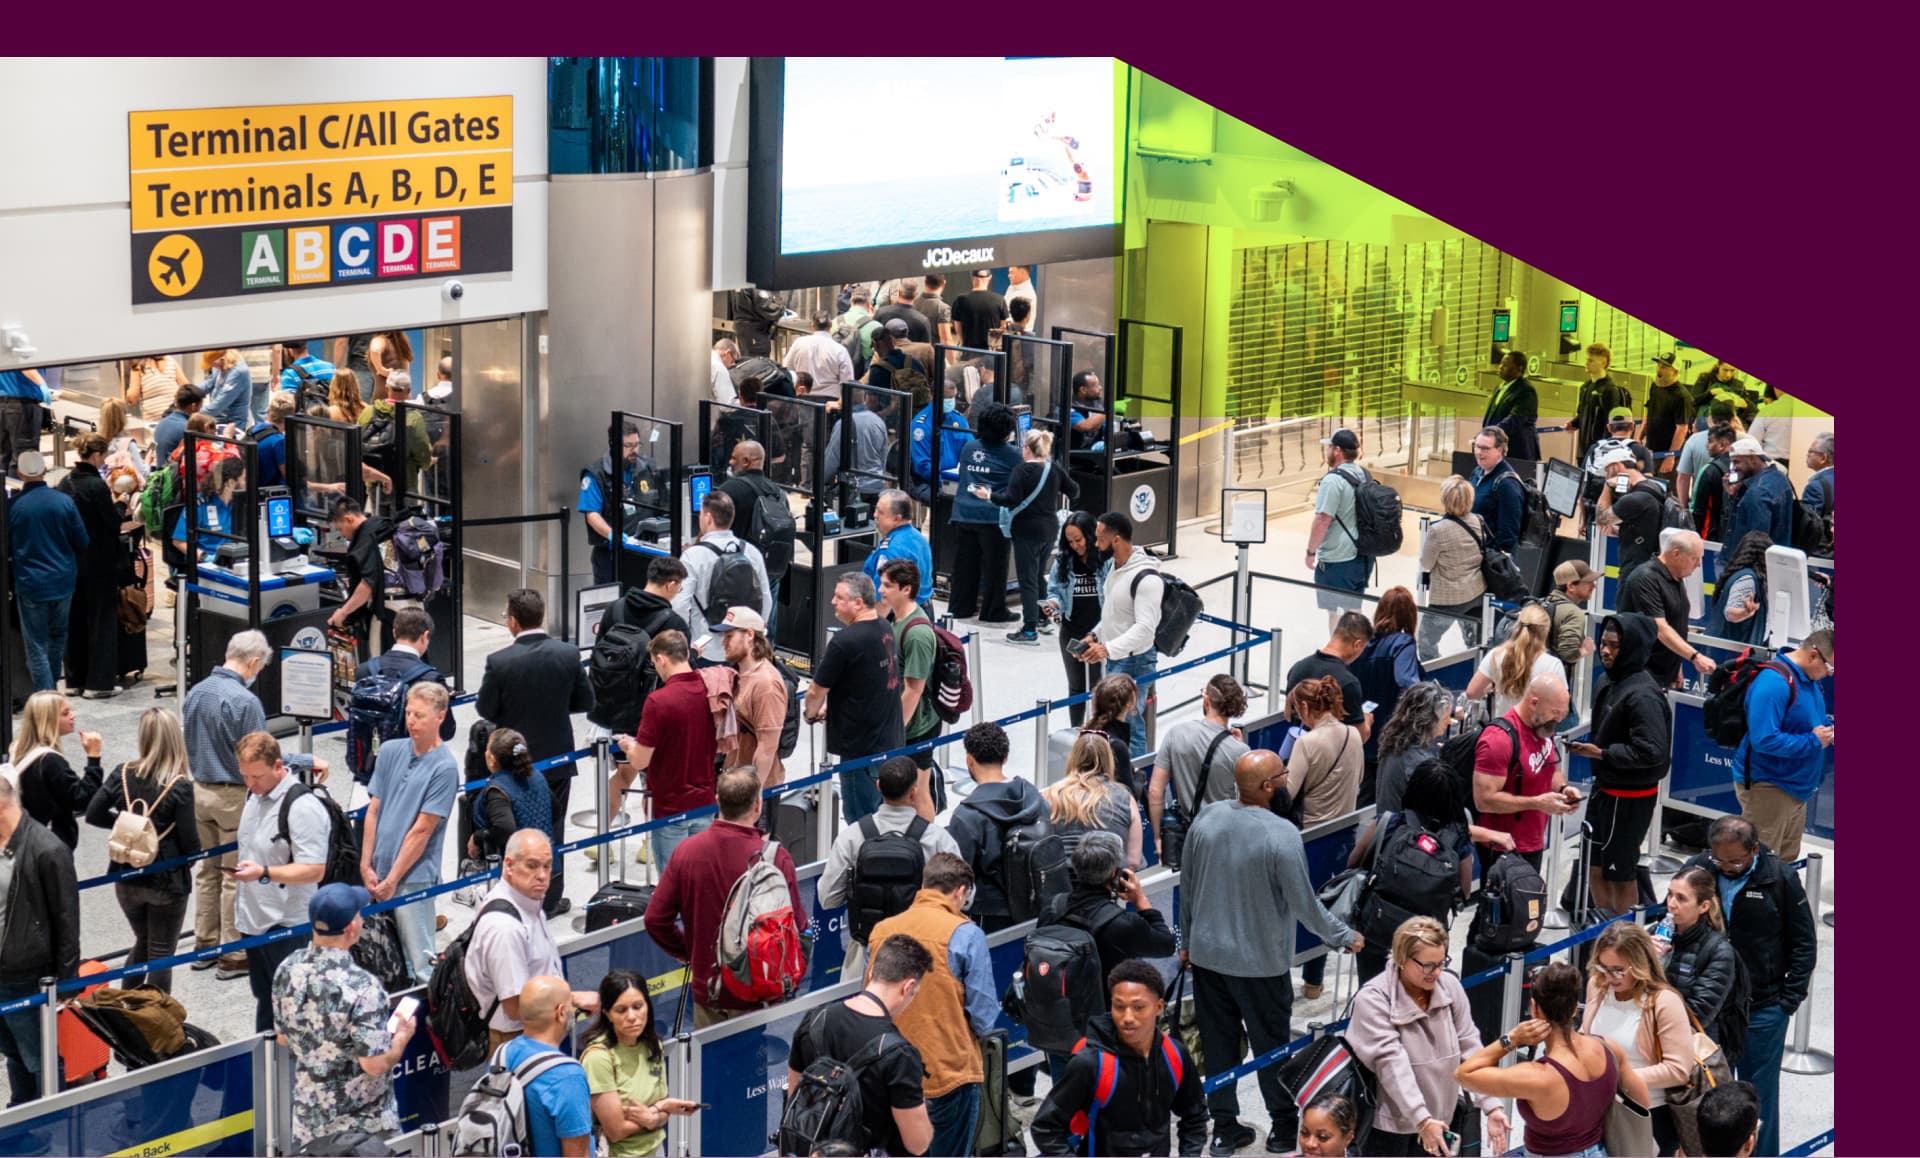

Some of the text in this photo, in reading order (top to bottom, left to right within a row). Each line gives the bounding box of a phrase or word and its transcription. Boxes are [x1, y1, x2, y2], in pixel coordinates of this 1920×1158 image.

[147, 111, 500, 158] Terminal C/All Gates
[148, 163, 496, 218] Terminals A, B, D, E
[246, 220, 454, 275] A B C D E
[922, 247, 994, 268] JCDecaux
[246, 275, 281, 286] TERMINAL
[338, 267, 371, 278] TERMINAL
[382, 263, 414, 273] TERMINAL
[425, 259, 457, 269] TERMINAL
[967, 464, 990, 474] CLEAR
[391, 1051, 441, 1079] CLEA
[746, 1085, 767, 1100] Less
[143, 1142, 171, 1158] Back
